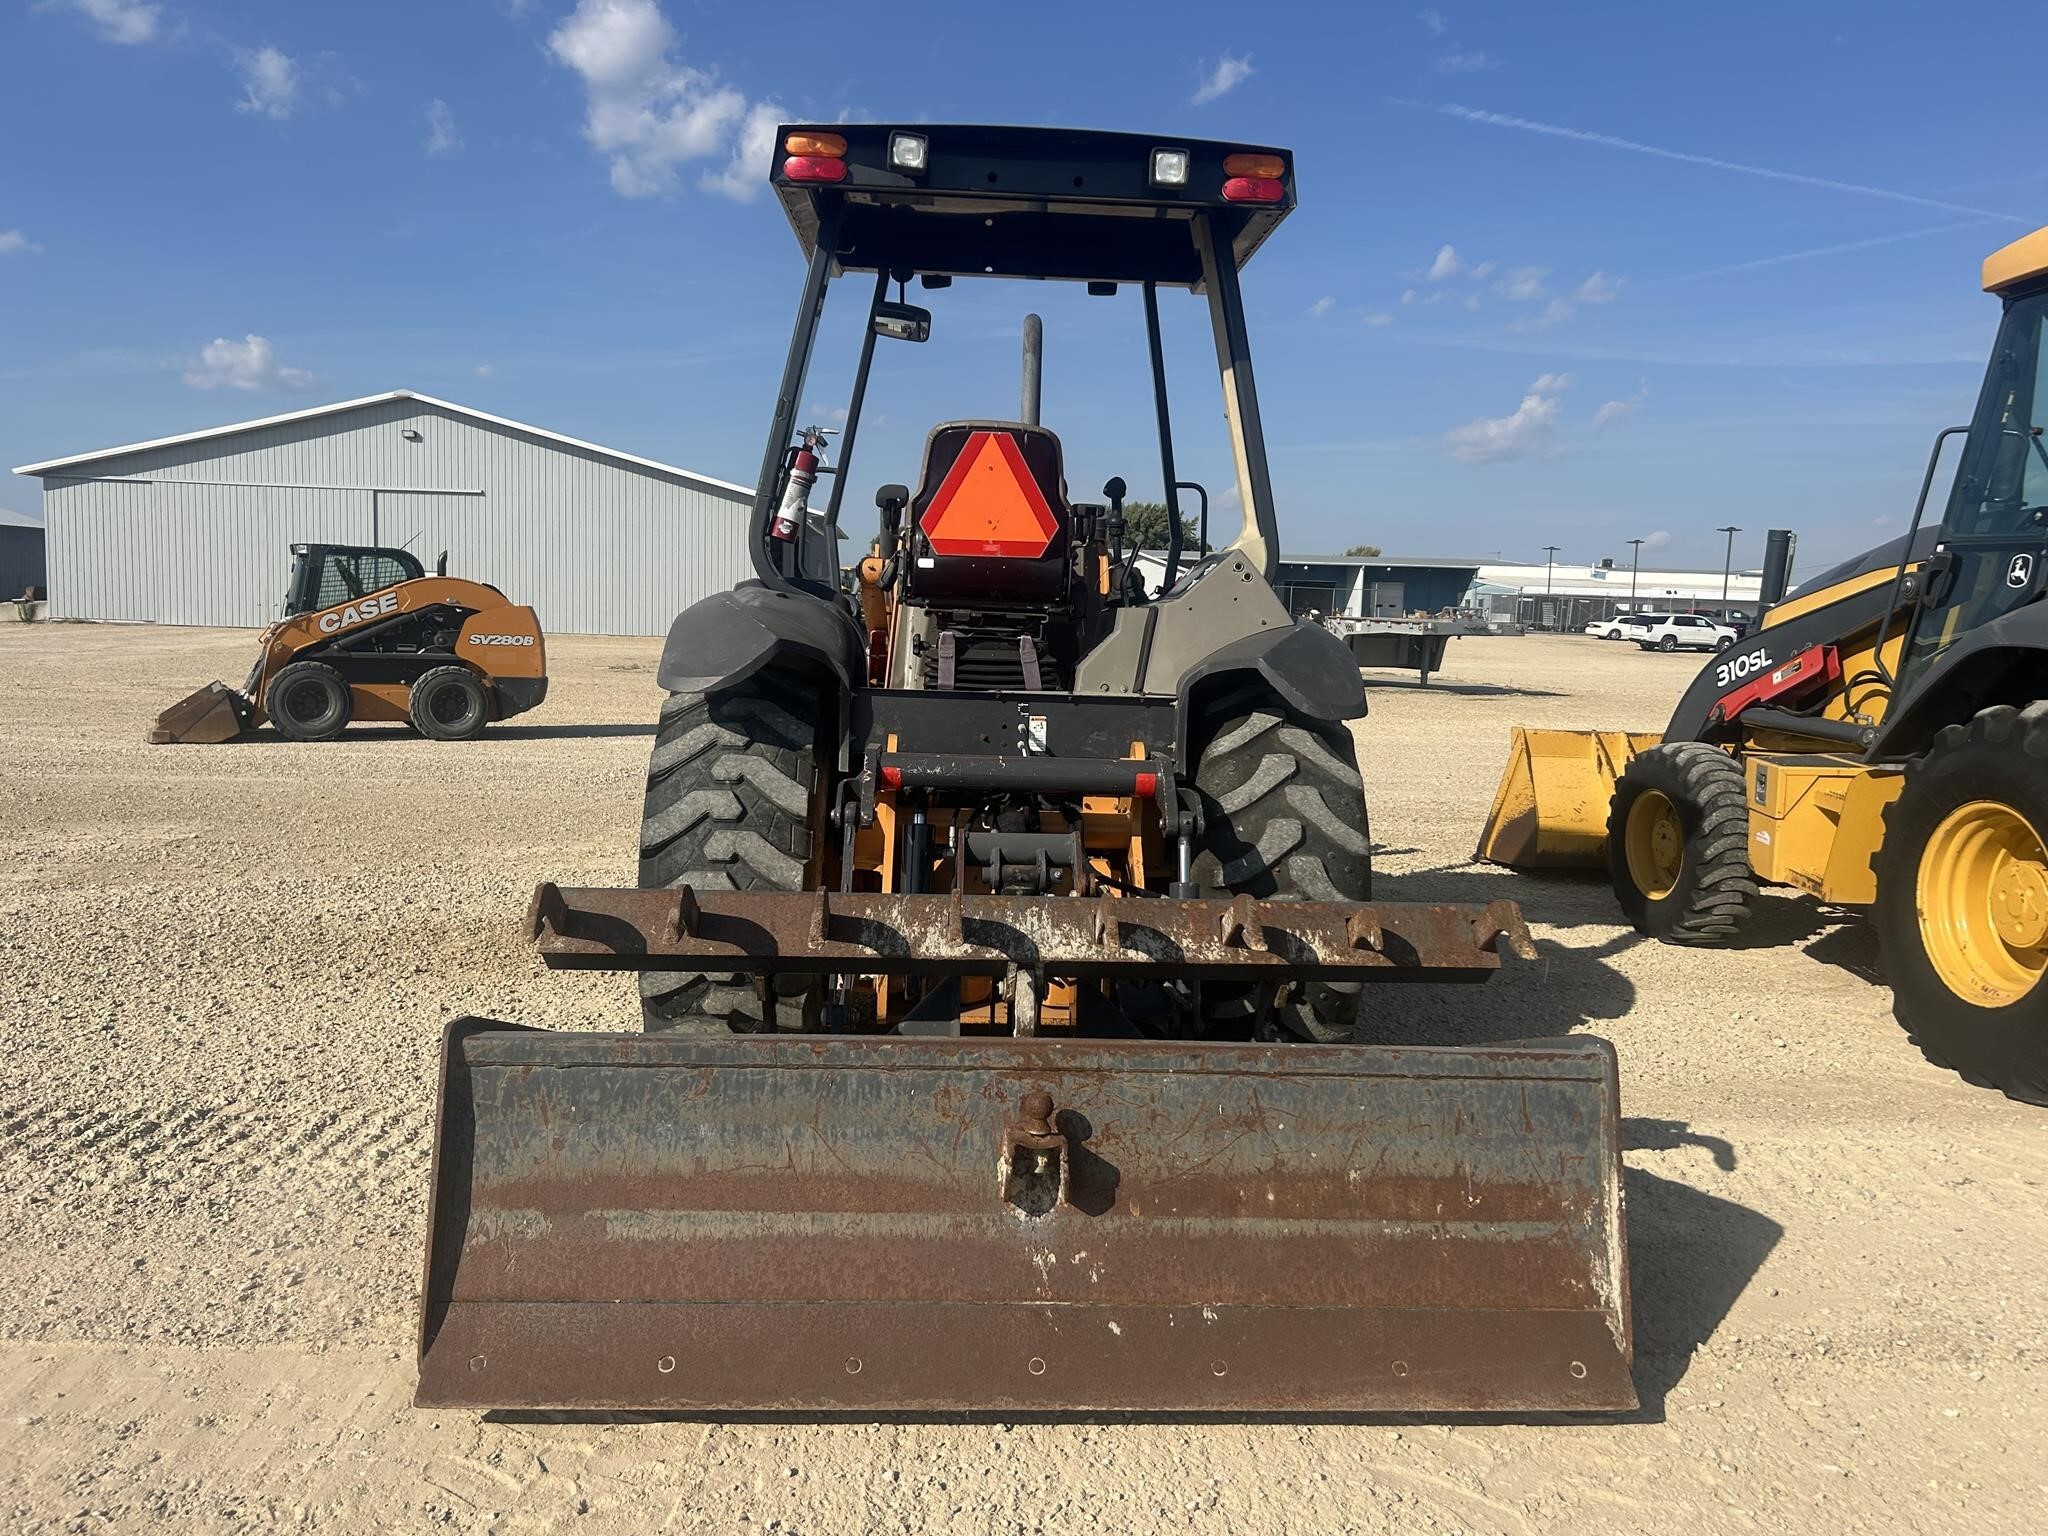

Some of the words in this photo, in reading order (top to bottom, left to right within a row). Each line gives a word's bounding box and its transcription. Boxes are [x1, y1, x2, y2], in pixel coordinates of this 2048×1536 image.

[319, 591, 399, 633] CASE
[468, 633, 535, 647] SV280B
[1716, 647, 1773, 687] 310SL
